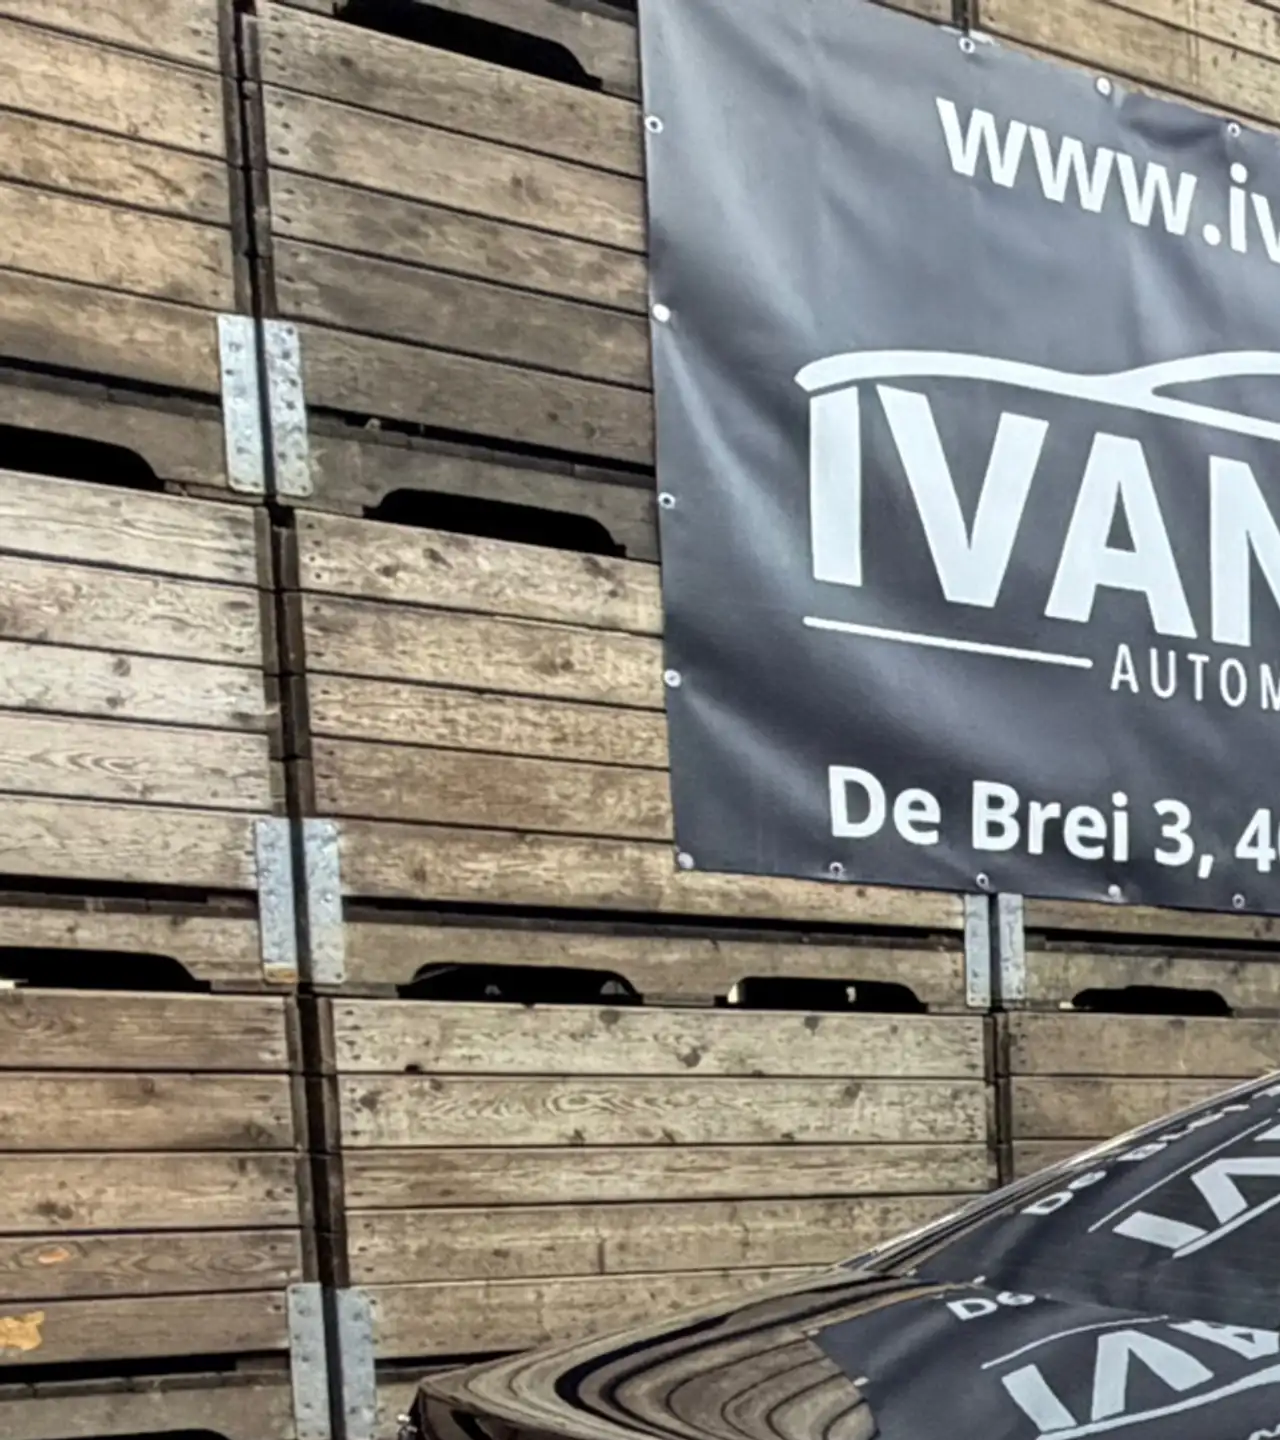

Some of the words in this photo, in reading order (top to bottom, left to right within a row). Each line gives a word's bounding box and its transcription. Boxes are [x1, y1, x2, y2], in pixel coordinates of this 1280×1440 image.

[827, 764, 941, 846] De
[971, 779, 1130, 866] Brei
[1153, 798, 1216, 880] 3,
